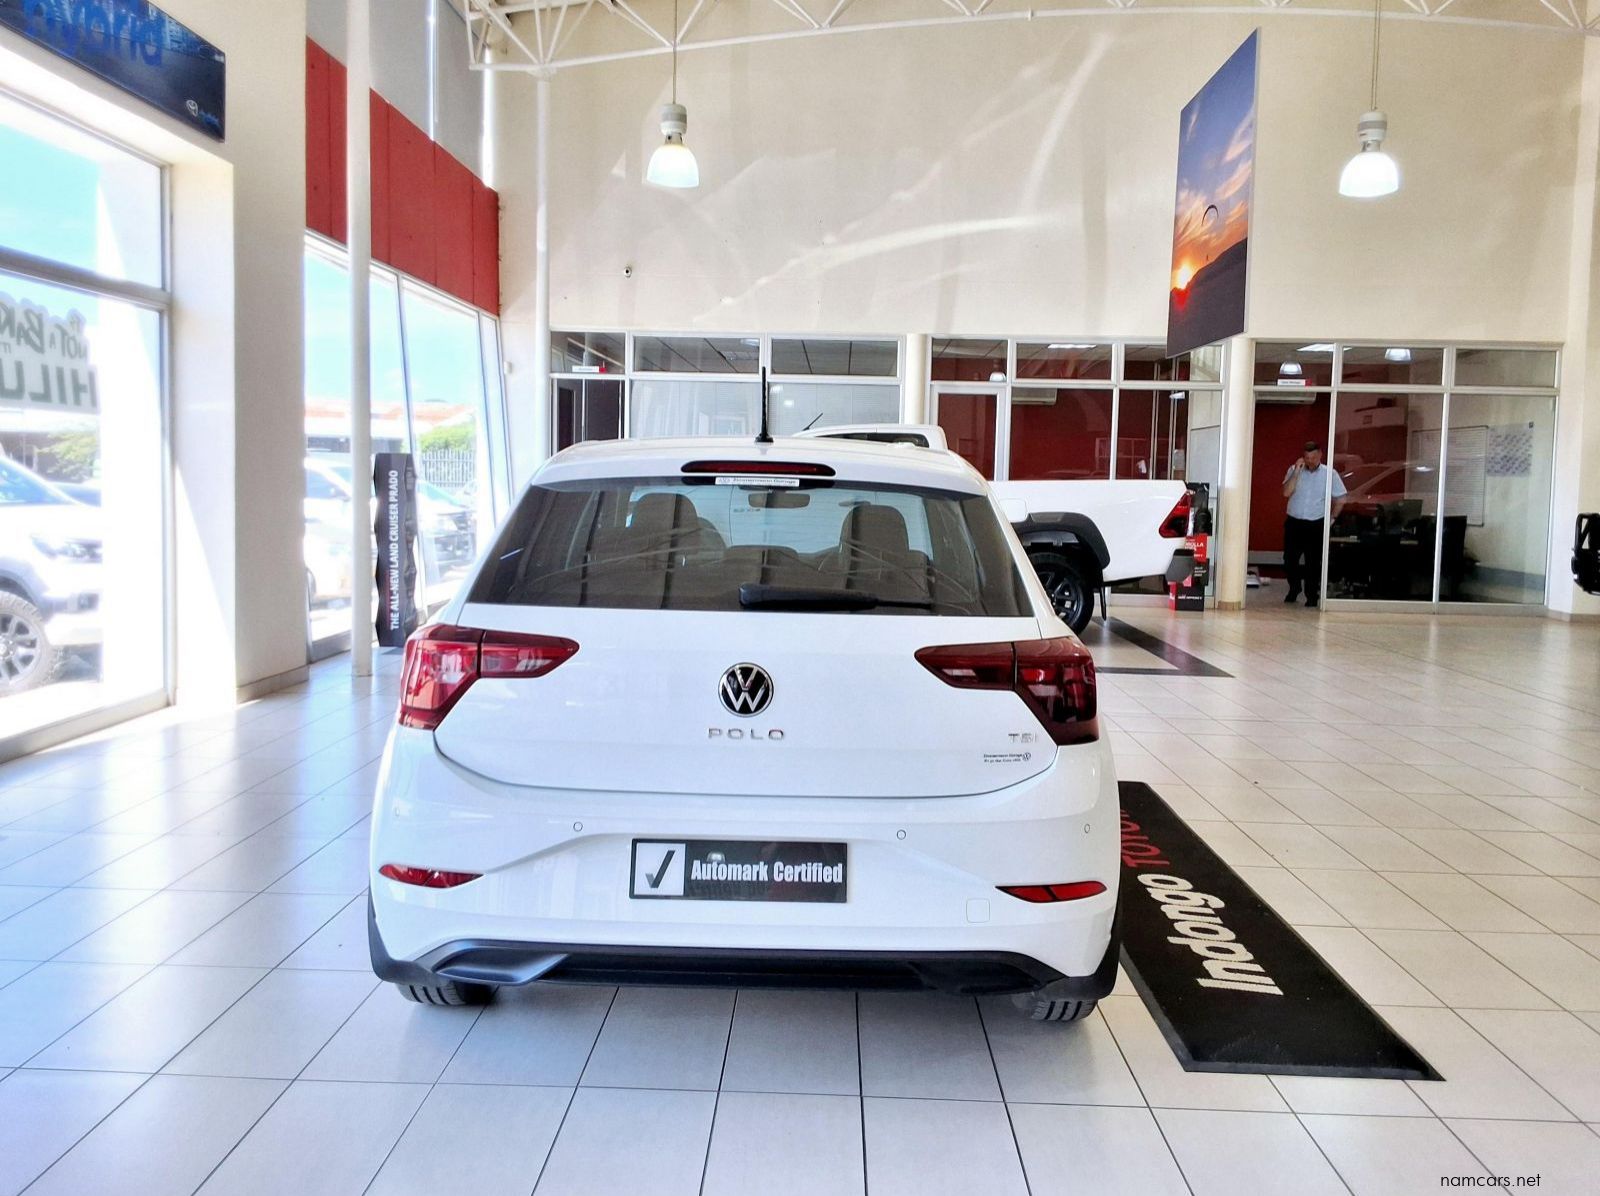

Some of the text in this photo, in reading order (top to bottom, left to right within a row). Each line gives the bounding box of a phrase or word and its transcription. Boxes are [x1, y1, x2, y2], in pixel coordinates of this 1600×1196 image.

[388, 470, 400, 631] THE ALL-NEW LAND CRUISER PRADO
[708, 728, 784, 741] POLO
[690, 860, 843, 883] Automark Certified
[1137, 873, 1284, 996] Indongo
